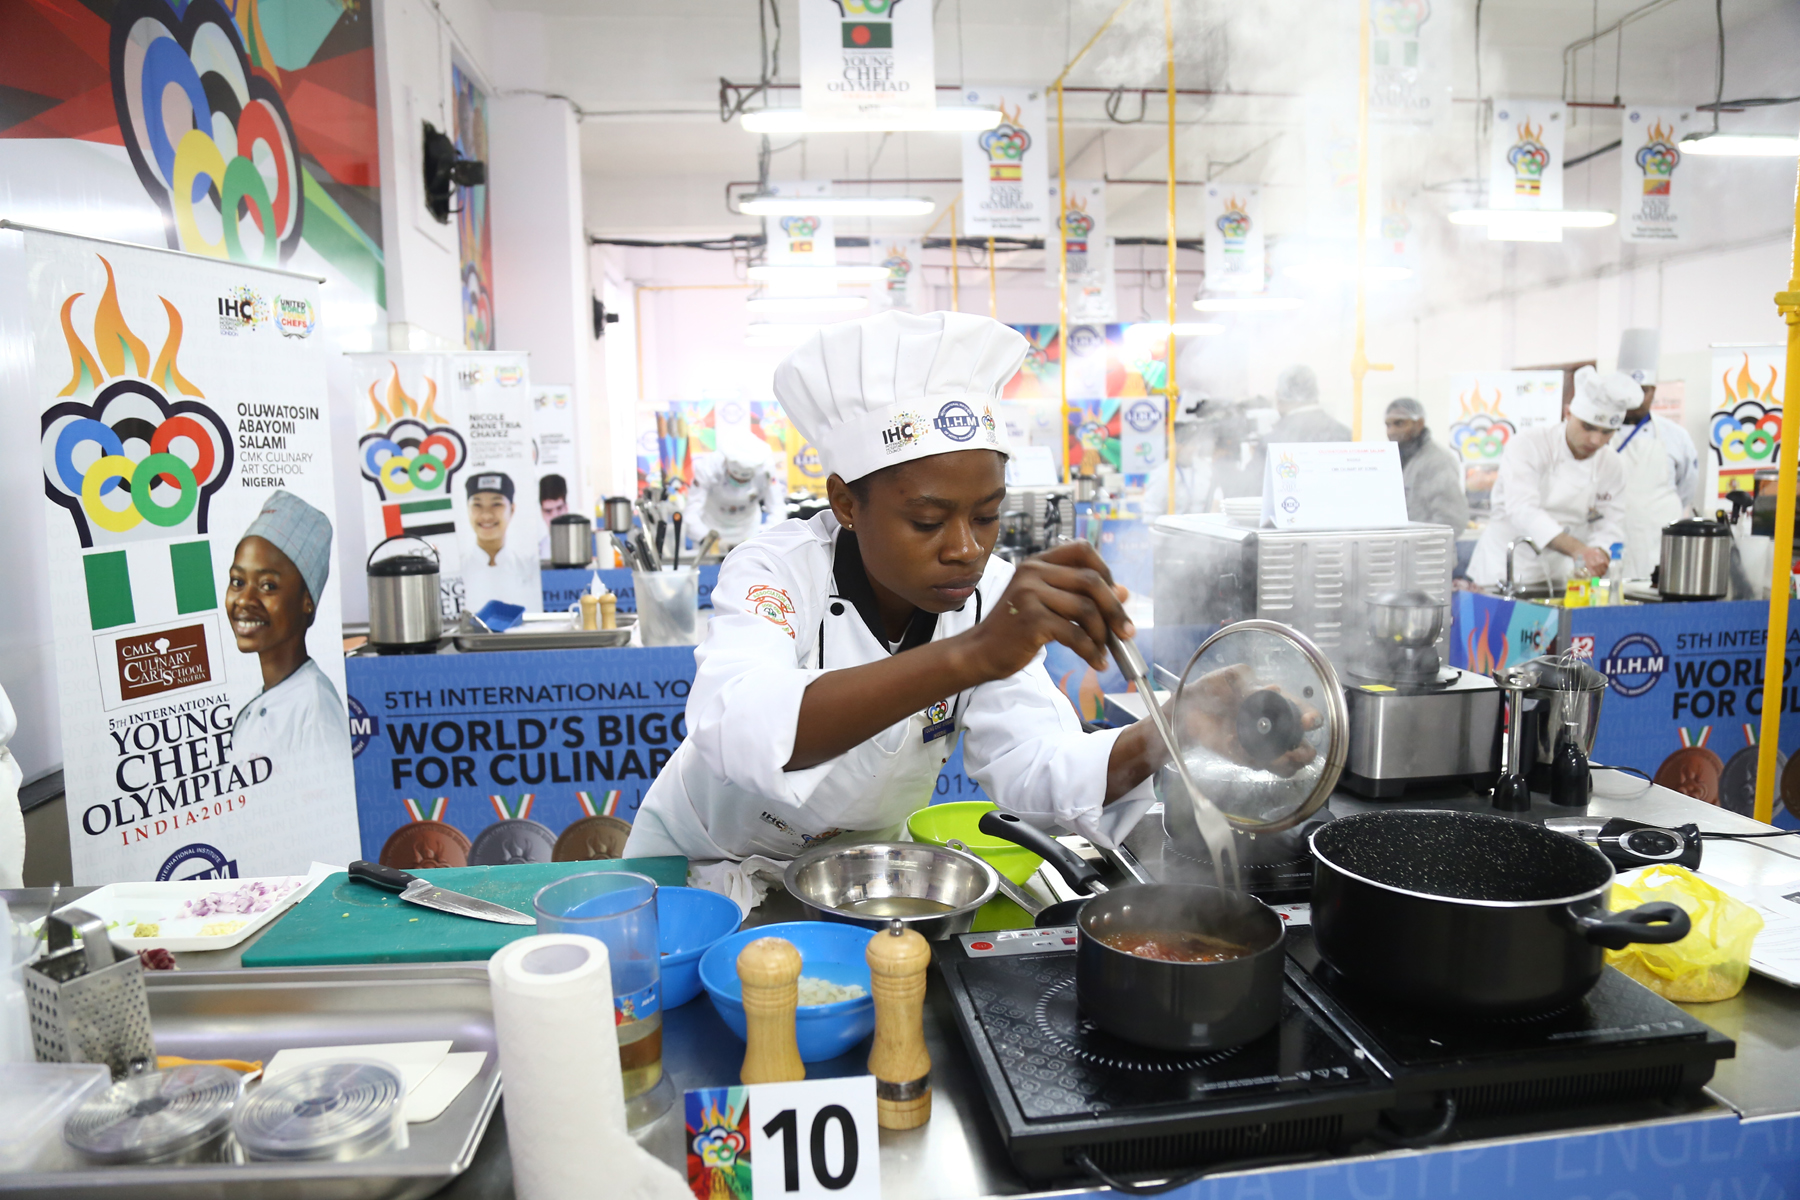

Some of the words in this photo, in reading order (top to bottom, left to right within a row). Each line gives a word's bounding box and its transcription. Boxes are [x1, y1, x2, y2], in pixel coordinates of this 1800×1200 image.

[842, 55, 895, 66] YOUNG
[843, 66, 894, 80] CHEF
[826, 80, 911, 92] OLYMPIAD
[218, 297, 254, 320] IHC
[280, 298, 306, 308] UNITED
[281, 318, 308, 329] CHEFS
[237, 402, 319, 420] OLUWATOSIN
[469, 413, 505, 421] NICOLE
[238, 419, 296, 434] ABAYOMI
[469, 422, 498, 430] ANNE
[937, 416, 978, 428] I.I.H.M
[239, 434, 287, 450] SALAMI
[470, 430, 509, 439] CHAVEZ
[882, 423, 914, 445] IHC
[239, 451, 264, 462] CMK
[265, 451, 313, 463] CULINARY
[241, 463, 260, 474] ART
[262, 463, 305, 475] SCHOOL
[242, 477, 286, 488] NIGERIA
[1521, 630, 1542, 648] IHC
[1676, 633, 1712, 649] 5TH
[122, 642, 155, 658] CMK
[1605, 656, 1664, 675] I.I.H.M
[162, 664, 206, 686] SCHOOL
[385, 690, 433, 710] 5TH
[440, 681, 650, 707] INTERNATIONAL
[1672, 689, 1736, 719] FOR
[109, 718, 127, 731] 5TH
[129, 693, 229, 725] INTERNATIONAL
[110, 703, 234, 757] YOUNG
[386, 715, 585, 755] WORLD'S
[115, 730, 235, 793] CHEF
[392, 756, 478, 789] FOR
[489, 747, 681, 787] CULINAR
[935, 773, 980, 795] 019
[82, 755, 273, 836] OLYMPIAD
[761, 1104, 860, 1193] 10
